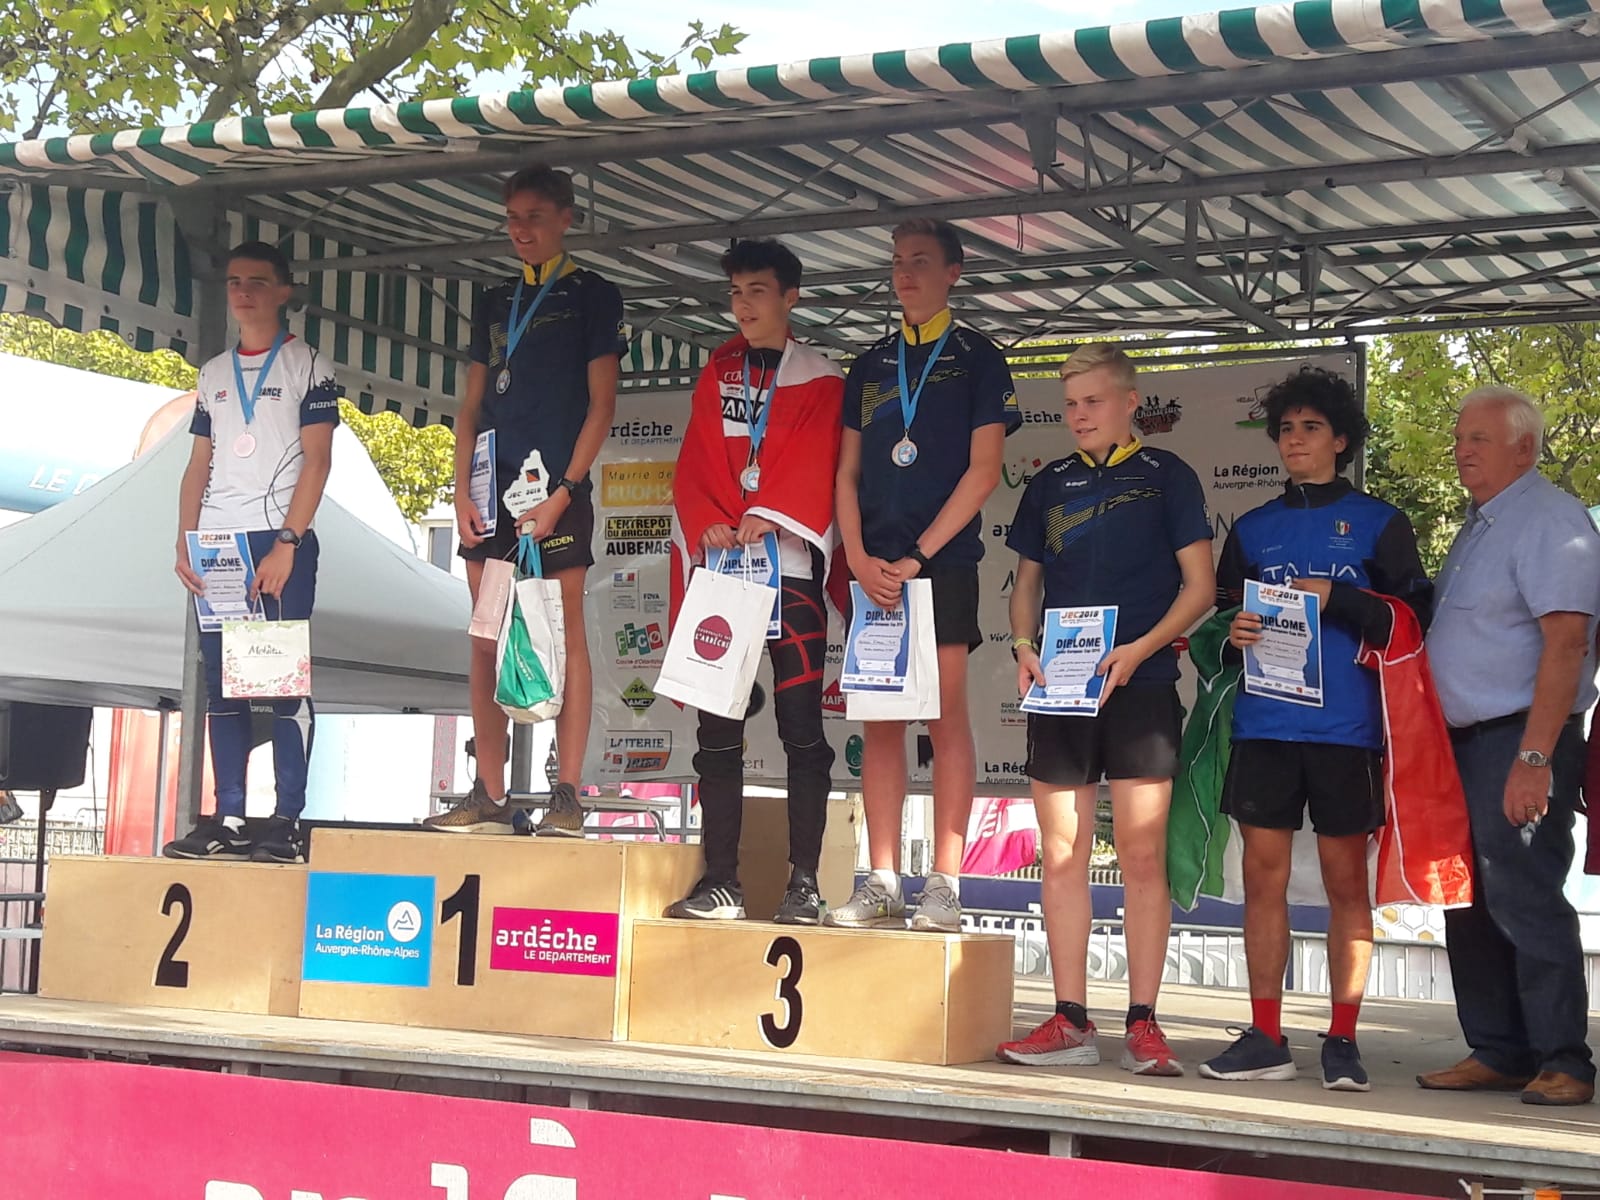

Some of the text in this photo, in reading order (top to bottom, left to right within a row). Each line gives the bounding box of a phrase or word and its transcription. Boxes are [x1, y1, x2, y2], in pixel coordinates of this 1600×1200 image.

[610, 416, 673, 437] rdèche
[608, 470, 672, 480] Mairie de
[1214, 464, 1279, 479] La Région
[1213, 478, 1286, 491] Auvergne-Rhône
[542, 535, 574, 549] WEDEN
[606, 540, 672, 555] AUBENAS
[201, 558, 241, 568] DIPLOME
[1260, 587, 1299, 601] JEC2018
[865, 610, 904, 621] DIPLOME
[1061, 610, 1100, 619] JEC2018
[1056, 637, 1102, 649] DIPLOME
[984, 761, 1027, 775] La Rég
[154, 882, 193, 988] 2
[316, 924, 384, 942] La Région
[440, 873, 481, 986] 1
[496, 918, 598, 951] ardèche
[315, 942, 420, 959] Auvergne-Rhône-Alpes
[523, 949, 612, 964] LE DEPARTEMENT
[760, 935, 804, 1049] 3
